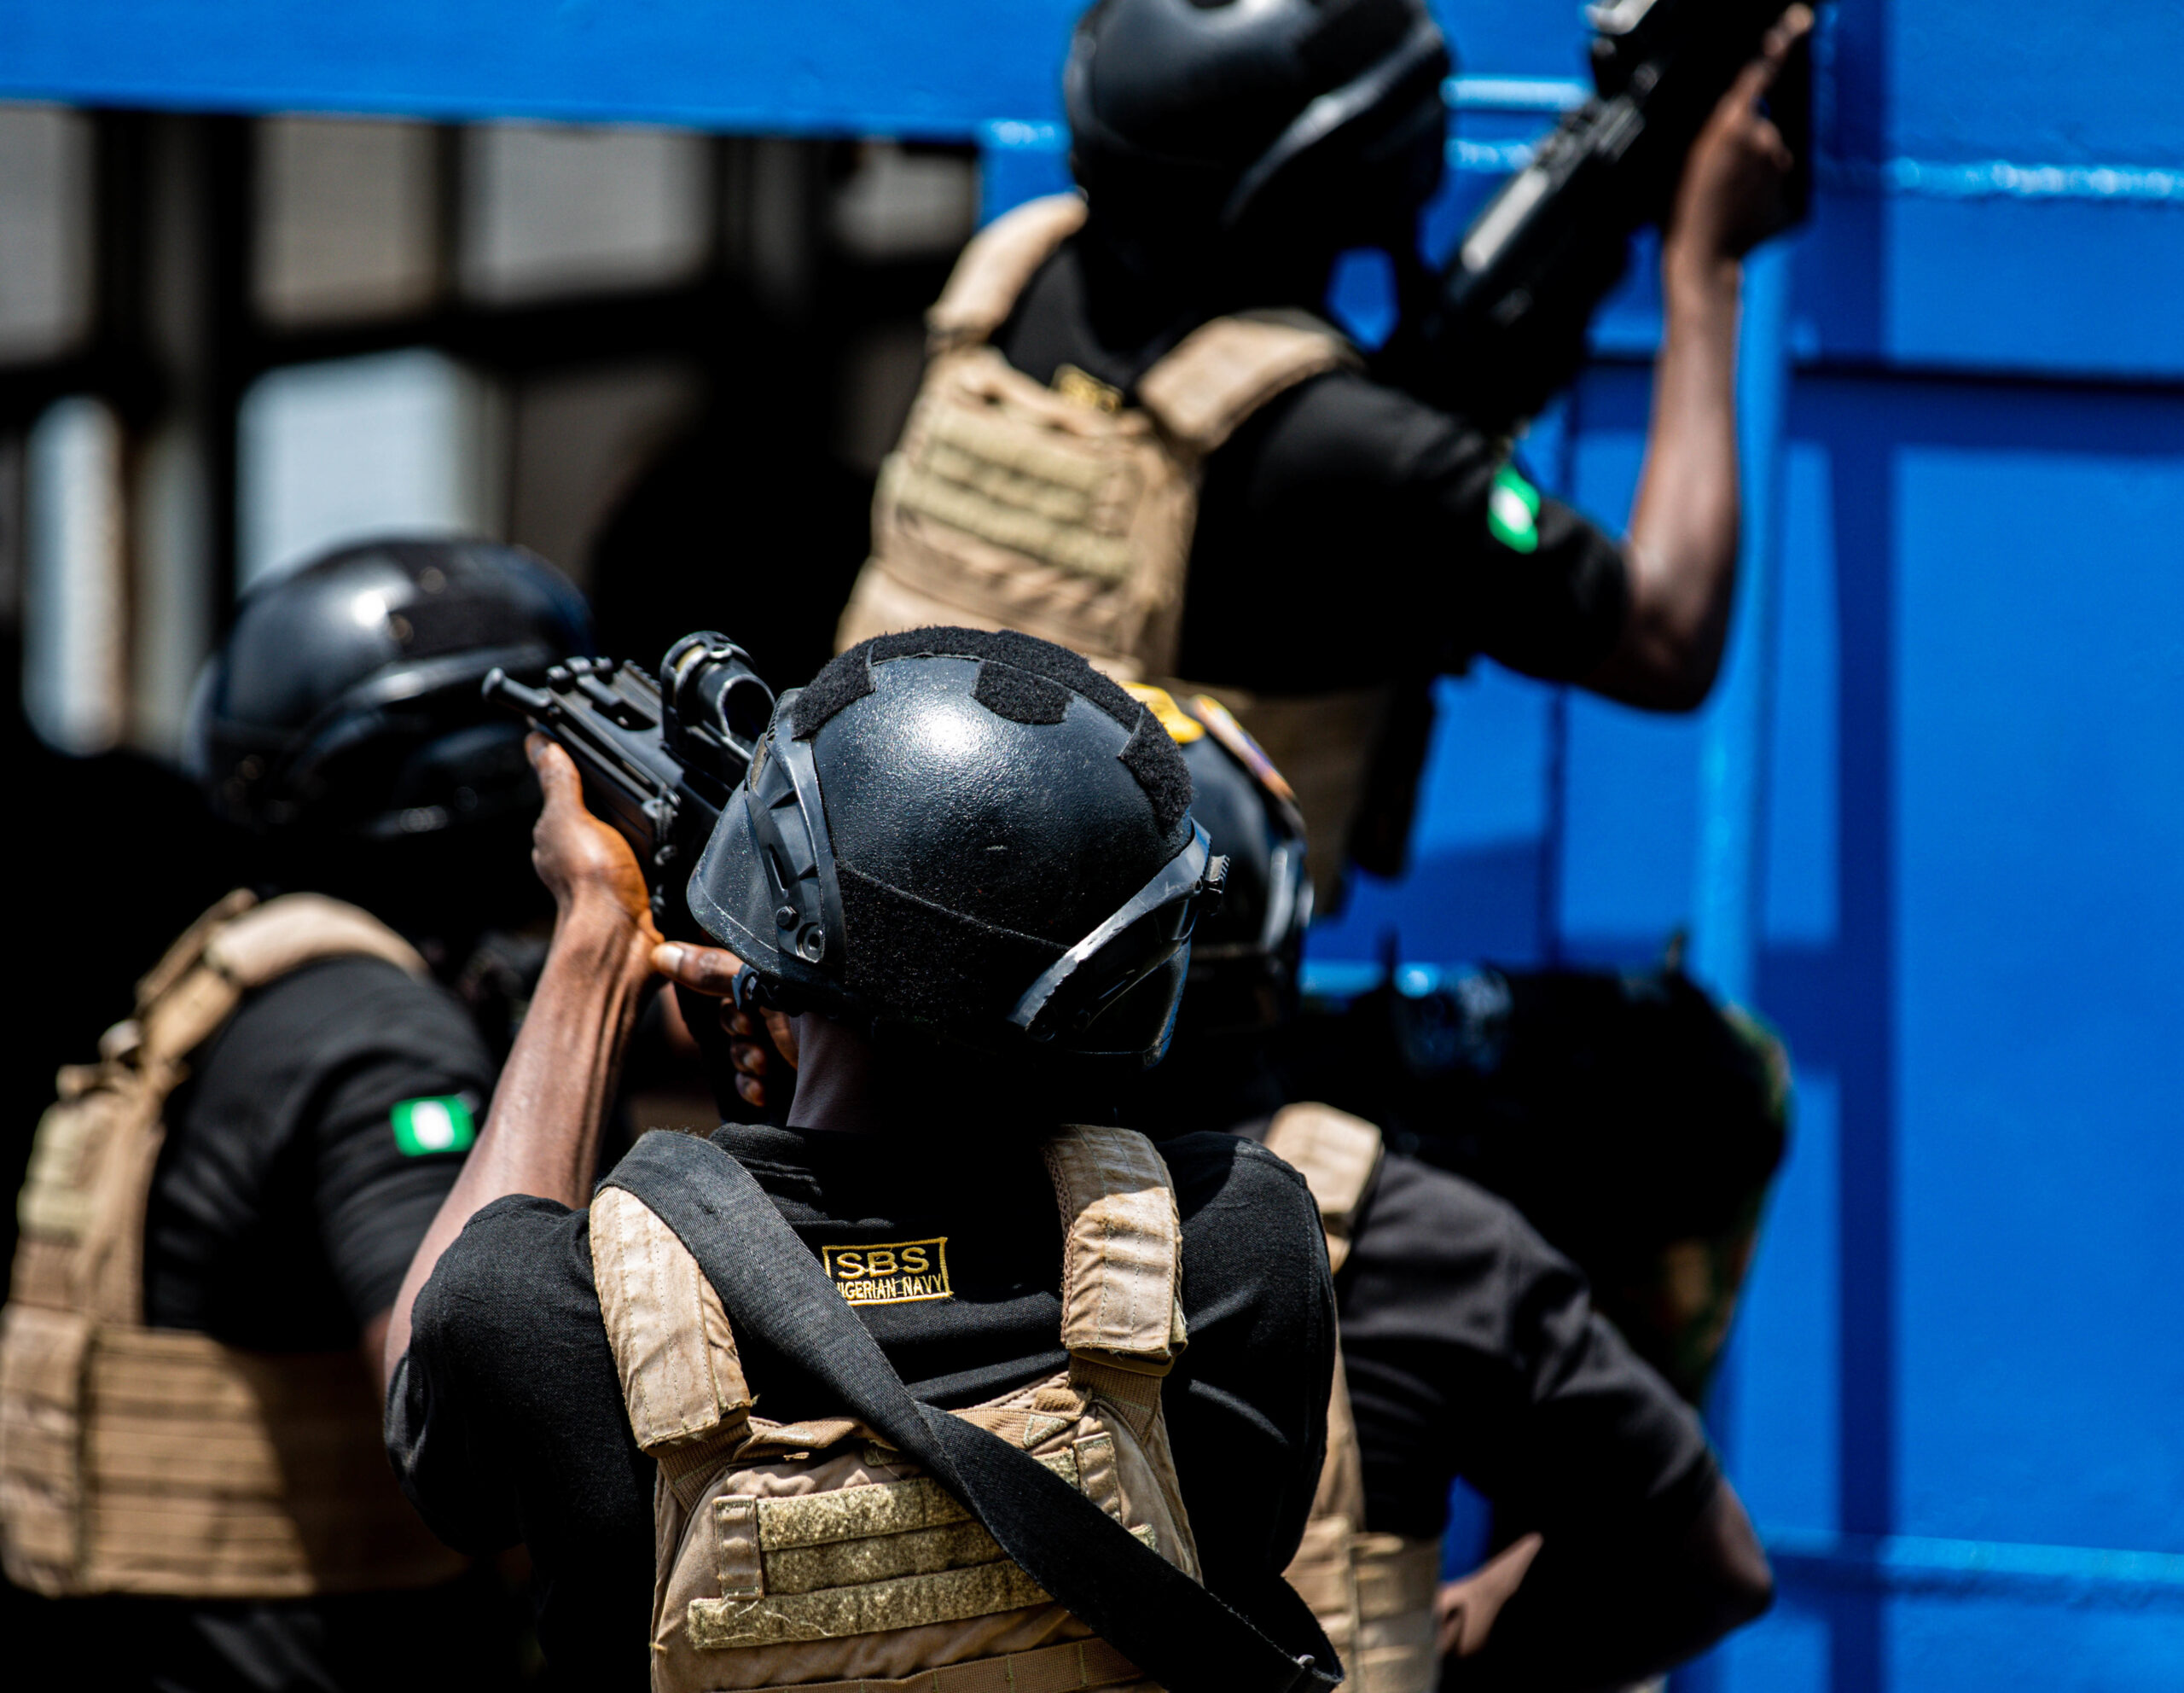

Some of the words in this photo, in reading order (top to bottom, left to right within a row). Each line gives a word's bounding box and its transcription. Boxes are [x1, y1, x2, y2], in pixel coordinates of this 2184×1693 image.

[836, 1247, 930, 1279] SBS
[836, 1277, 896, 1300] IGERIAN
[903, 1272, 942, 1297] NAVY
